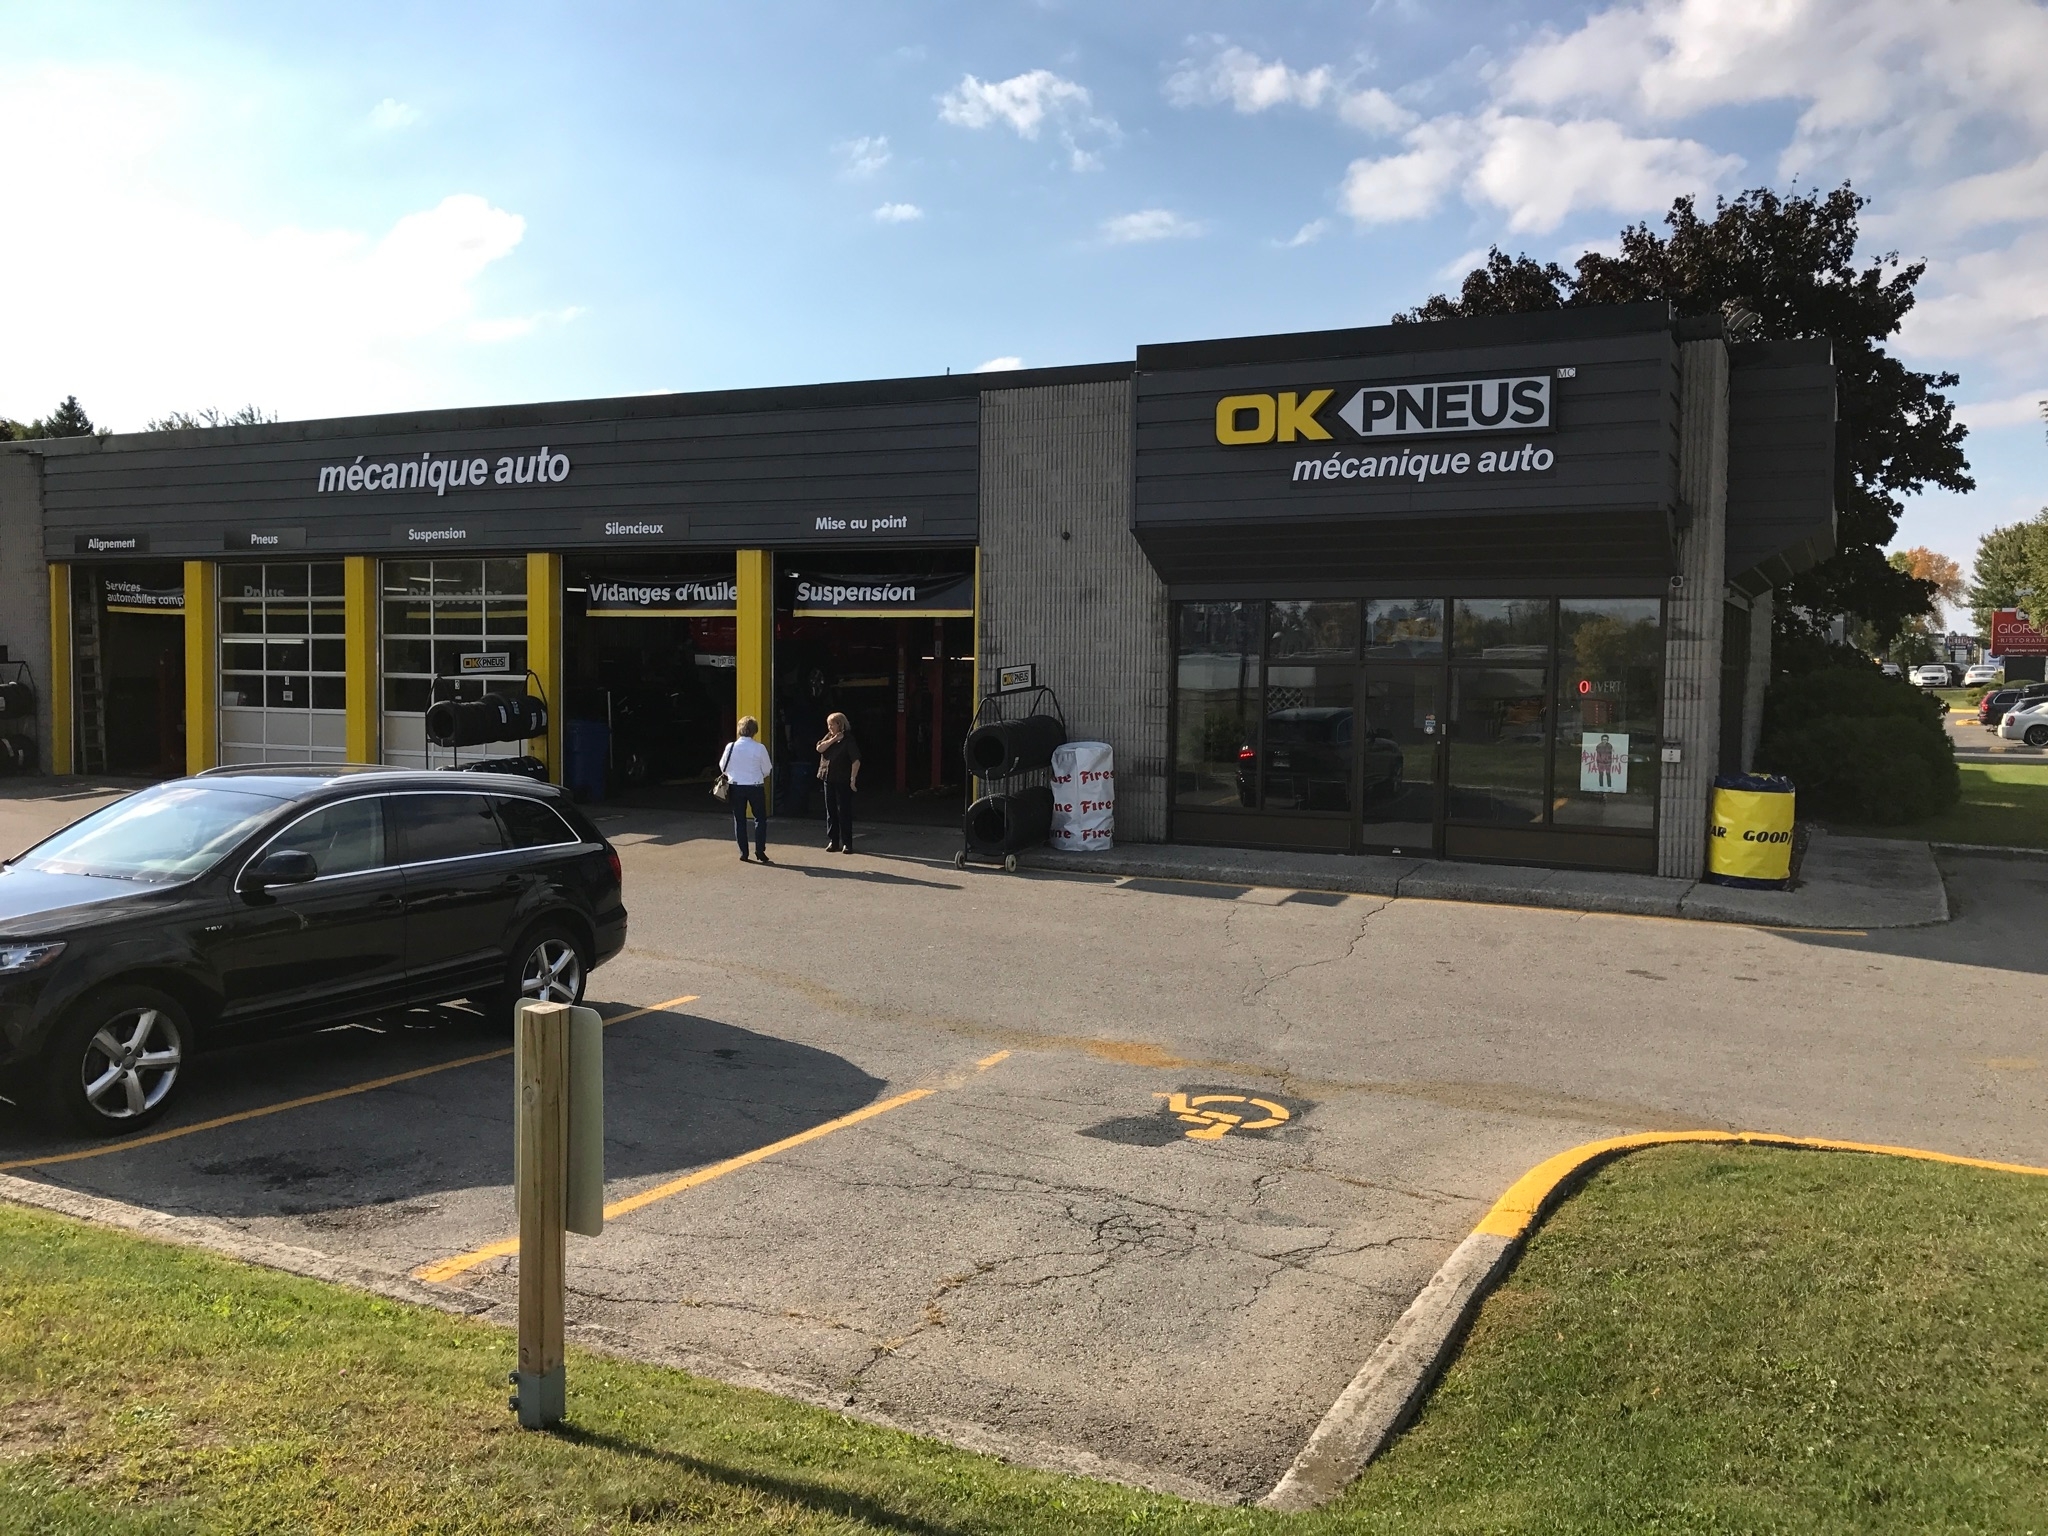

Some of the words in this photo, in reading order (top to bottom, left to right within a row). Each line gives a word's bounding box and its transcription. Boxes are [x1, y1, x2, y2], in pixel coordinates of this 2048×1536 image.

[1557, 367, 1576, 378] MC
[1215, 388, 1335, 446] OK
[1362, 380, 1545, 433] PNEUS
[1292, 448, 1471, 483] mécanique
[1477, 443, 1554, 473] auto
[318, 452, 489, 496] mécanique
[494, 446, 571, 485] auto
[605, 521, 664, 535] Silencieux
[815, 516, 847, 530] Mise
[850, 519, 868, 529] au
[872, 514, 908, 532] point
[250, 533, 279, 545] Pneus
[408, 527, 467, 543] Suspension
[87, 537, 136, 552] Alignement
[105, 580, 141, 593] Services
[244, 585, 285, 598] Pnus
[590, 583, 671, 605] Vidanges
[675, 581, 738, 601] d'huile
[797, 582, 916, 605] Suspension
[107, 592, 157, 605] automobiles
[158, 594, 185, 606] comp
[463, 657, 480, 668] OK
[482, 657, 504, 667] PNEUS
[1579, 680, 1622, 694] OUVERT
